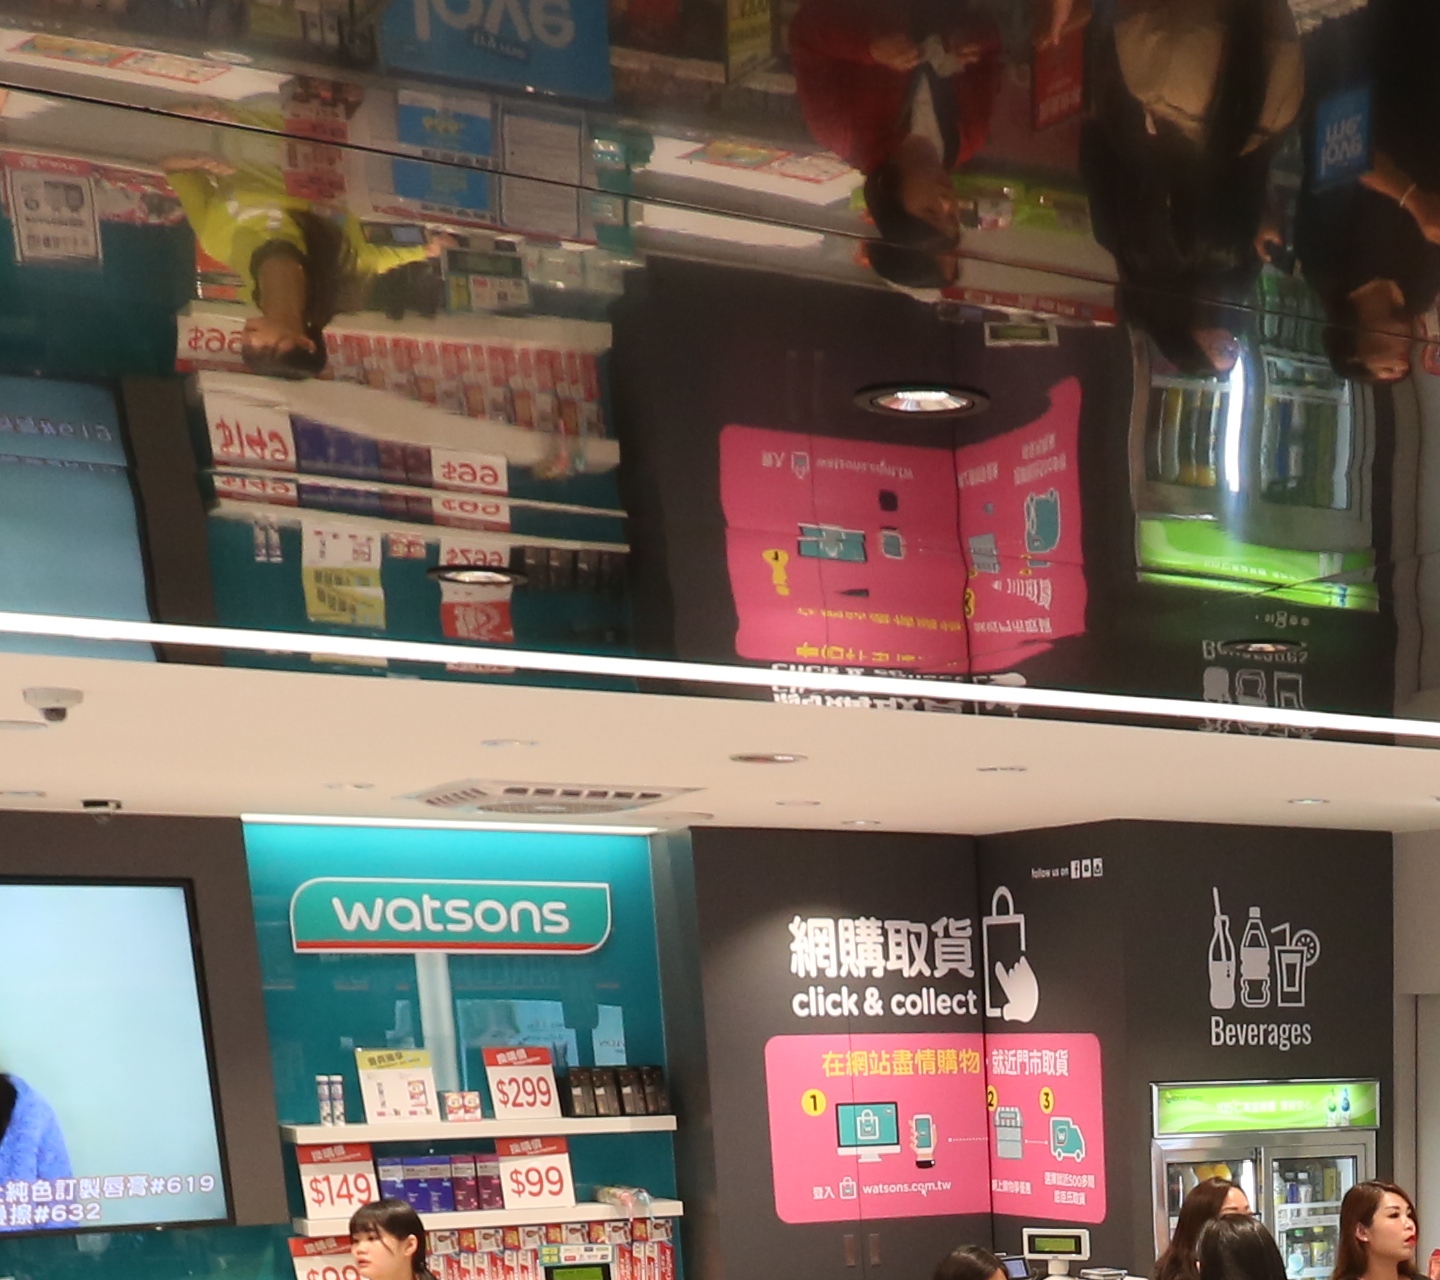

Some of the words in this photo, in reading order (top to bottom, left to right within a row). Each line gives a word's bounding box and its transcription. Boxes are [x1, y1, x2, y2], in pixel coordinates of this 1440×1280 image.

[332, 895, 571, 935] watsons
[788, 915, 975, 979] 網購取貨
[792, 987, 859, 1017] click
[863, 987, 884, 1016] &
[891, 986, 978, 1016] collect
[1212, 1015, 1312, 1051] Beverages
[822, 1049, 980, 1077] 在網站盡情購物
[991, 1048, 1069, 1077] 就近門市取貨
[497, 1076, 552, 1108] $299
[810, 1095, 818, 1111] 1
[987, 1093, 995, 1109] 2
[1043, 1096, 1051, 1111] 3
[310, 1172, 373, 1208] $149
[509, 1165, 564, 1198] $99
[812, 1186, 836, 1200] 登入
[862, 1180, 952, 1195] watsons.com.tw
